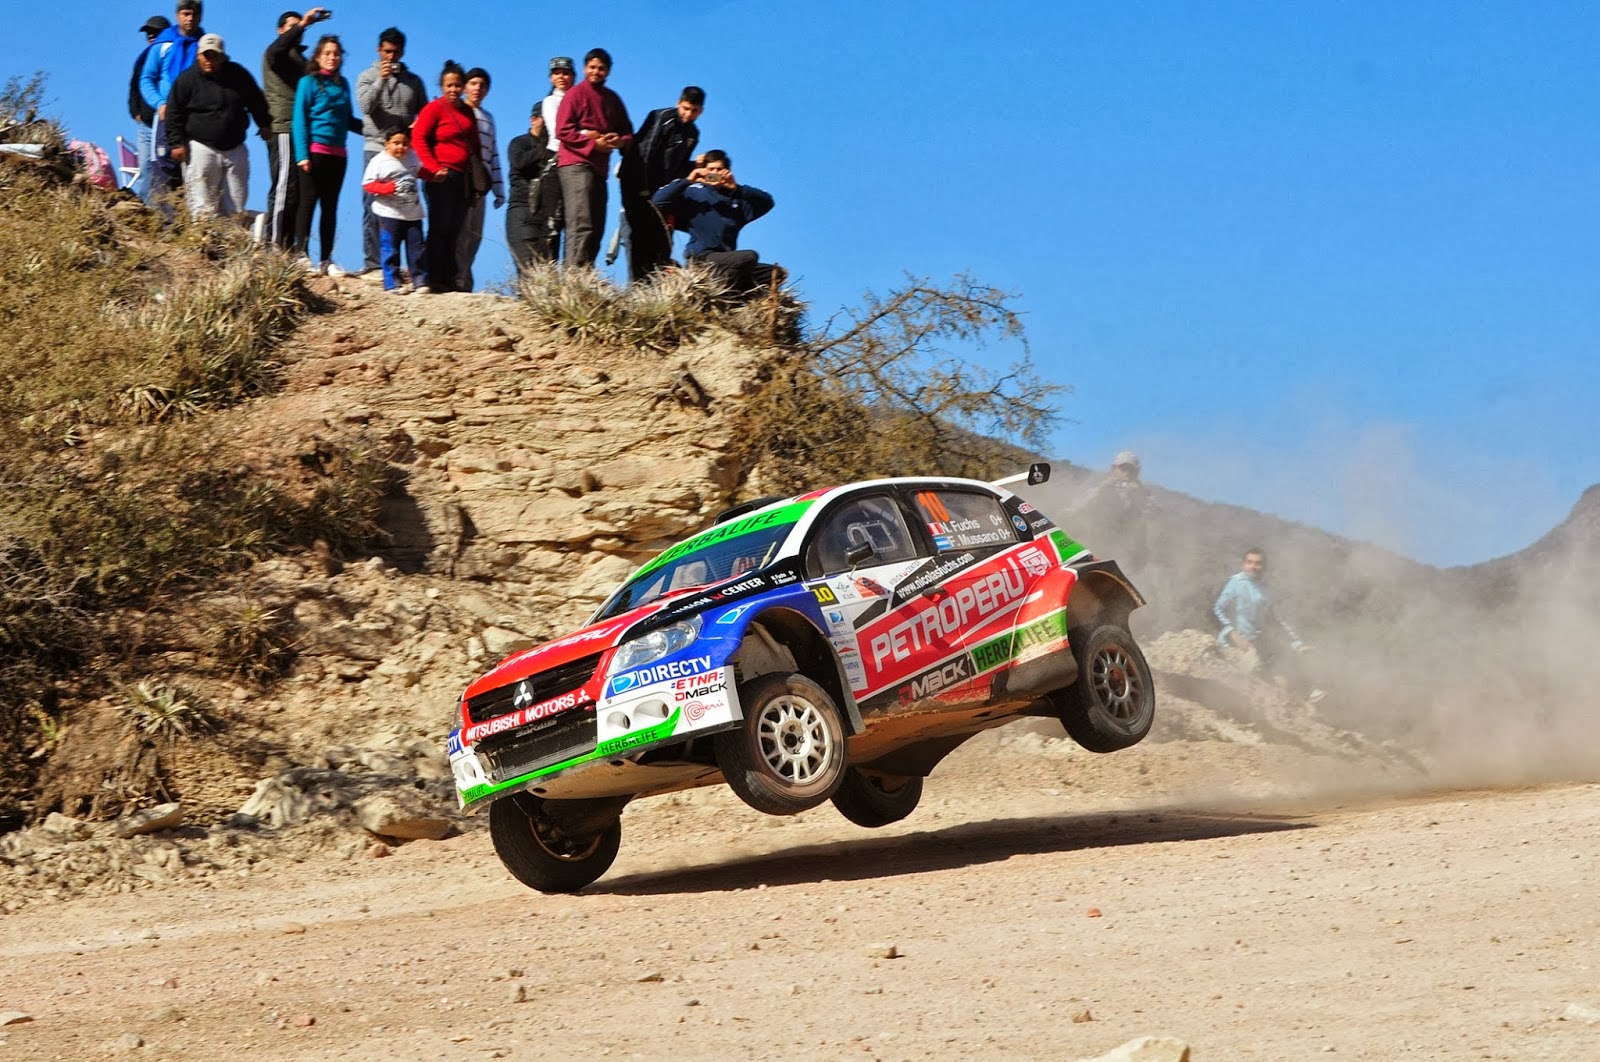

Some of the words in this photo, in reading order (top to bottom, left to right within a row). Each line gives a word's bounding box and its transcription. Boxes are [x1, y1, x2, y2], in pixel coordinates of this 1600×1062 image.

[917, 490, 949, 523] 10
[651, 511, 783, 568] HERBALIFE
[952, 519, 980, 532] Fuchs
[961, 531, 998, 546] Mussano
[721, 577, 766, 596] CENTER
[896, 552, 975, 600] www.nicolasfuchs.com
[814, 586, 834, 603] 10
[871, 557, 1025, 673] PETROPERU
[974, 619, 1059, 669] HERBALIFE
[641, 656, 711, 686] DIRECTV
[676, 672, 718, 690] ETNA
[465, 713, 520, 741] MITSUBISHI
[525, 693, 576, 723] MOTORS
[600, 729, 658, 755] HERBALIFE
